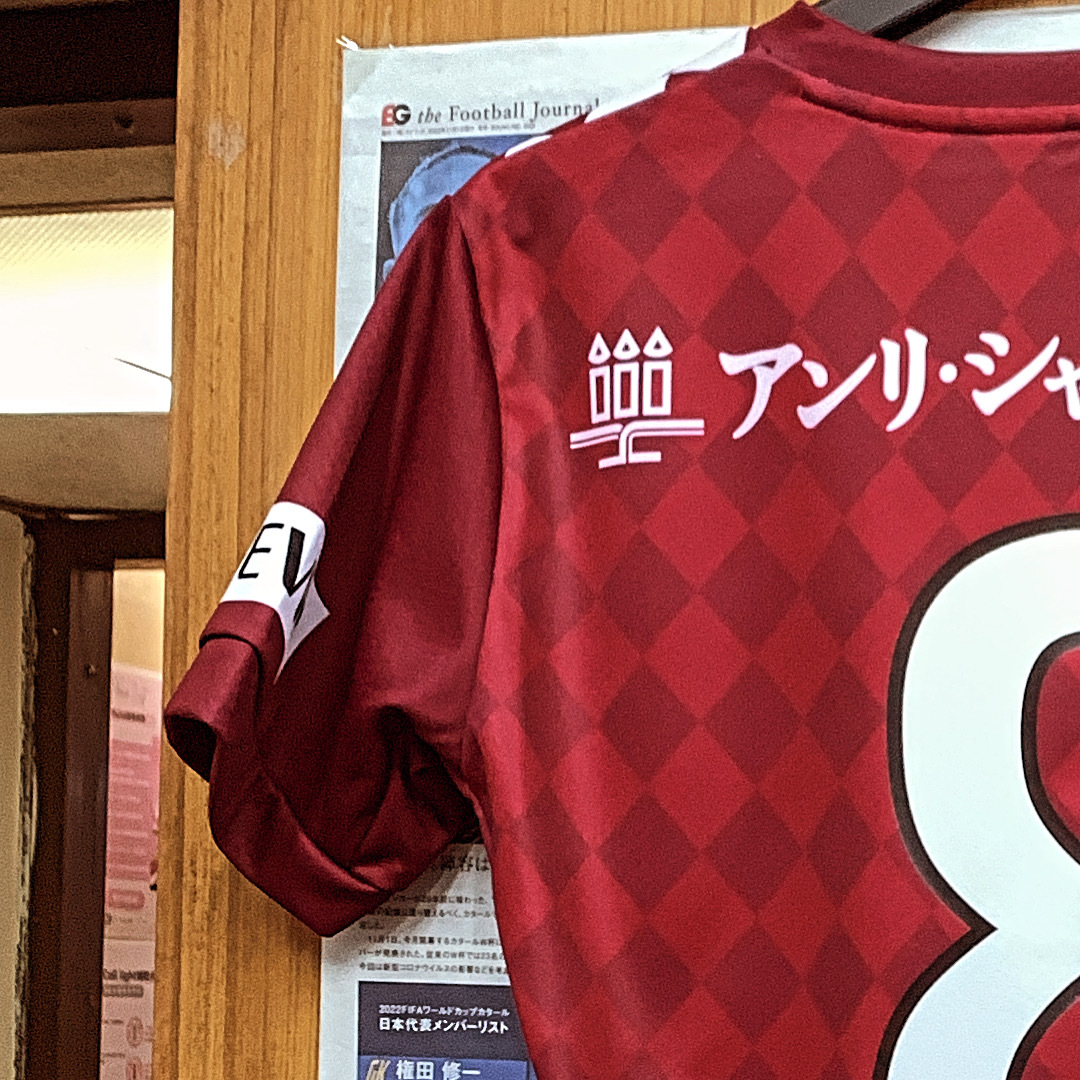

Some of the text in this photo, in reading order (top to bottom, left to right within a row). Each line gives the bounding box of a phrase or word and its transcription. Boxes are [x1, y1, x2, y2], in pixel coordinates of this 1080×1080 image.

[418, 106, 442, 124] the
[449, 101, 526, 123] Football
[378, 1017, 510, 1035] 日本代表メンバーリスト
[395, 1059, 435, 1080] 権田
